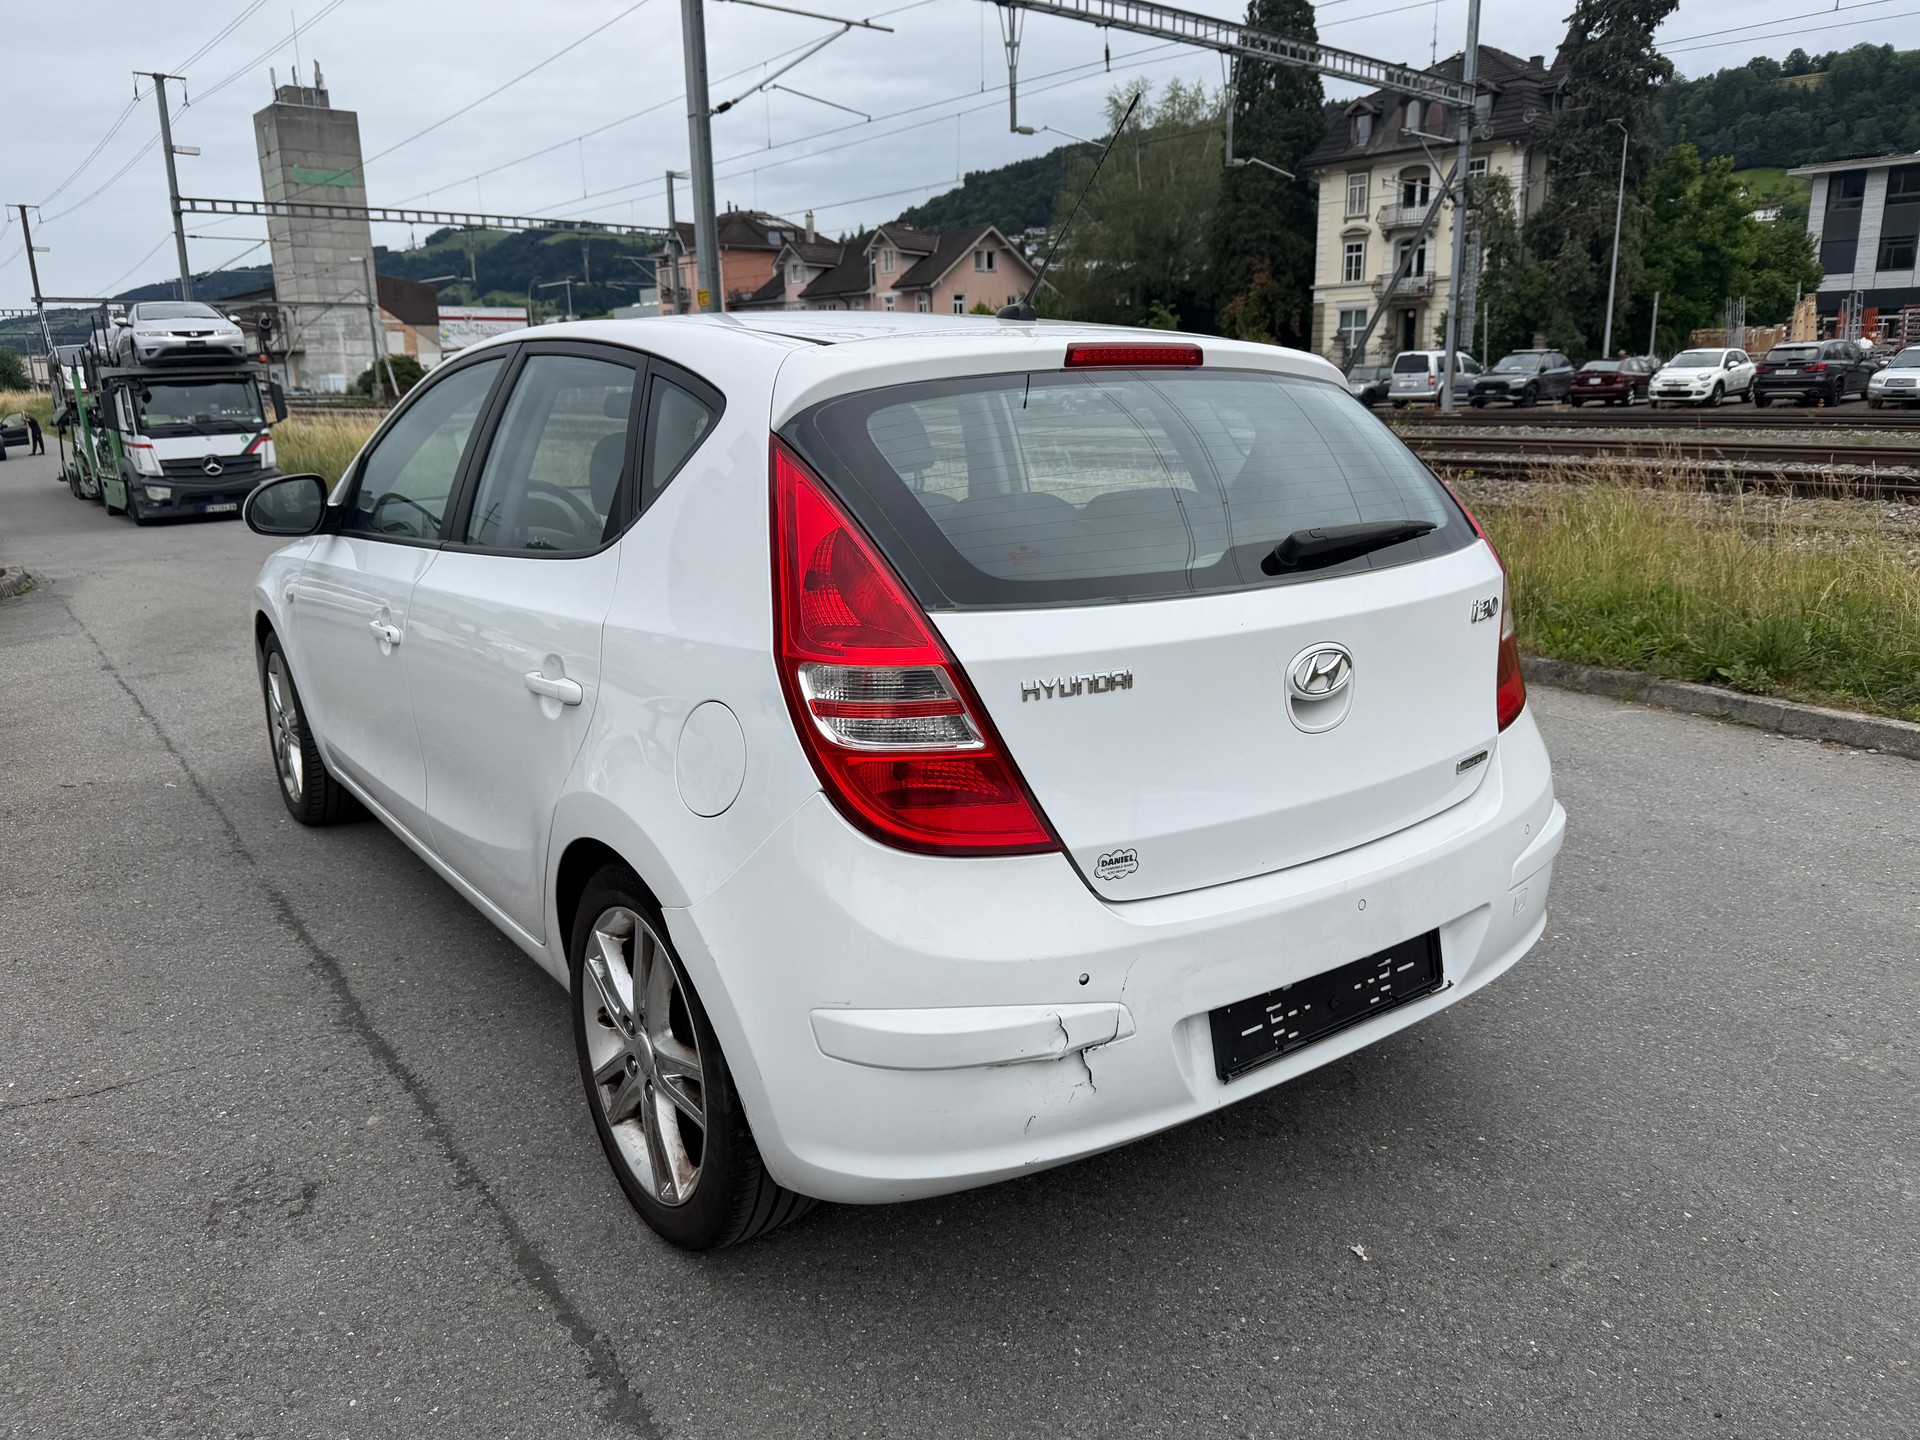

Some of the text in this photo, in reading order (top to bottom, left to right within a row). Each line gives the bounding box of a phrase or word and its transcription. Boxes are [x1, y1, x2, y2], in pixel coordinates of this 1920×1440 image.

[1471, 596, 1499, 624] i30
[1020, 668, 1134, 703] HYUNDAI
[1101, 855, 1133, 867] DANIEL
